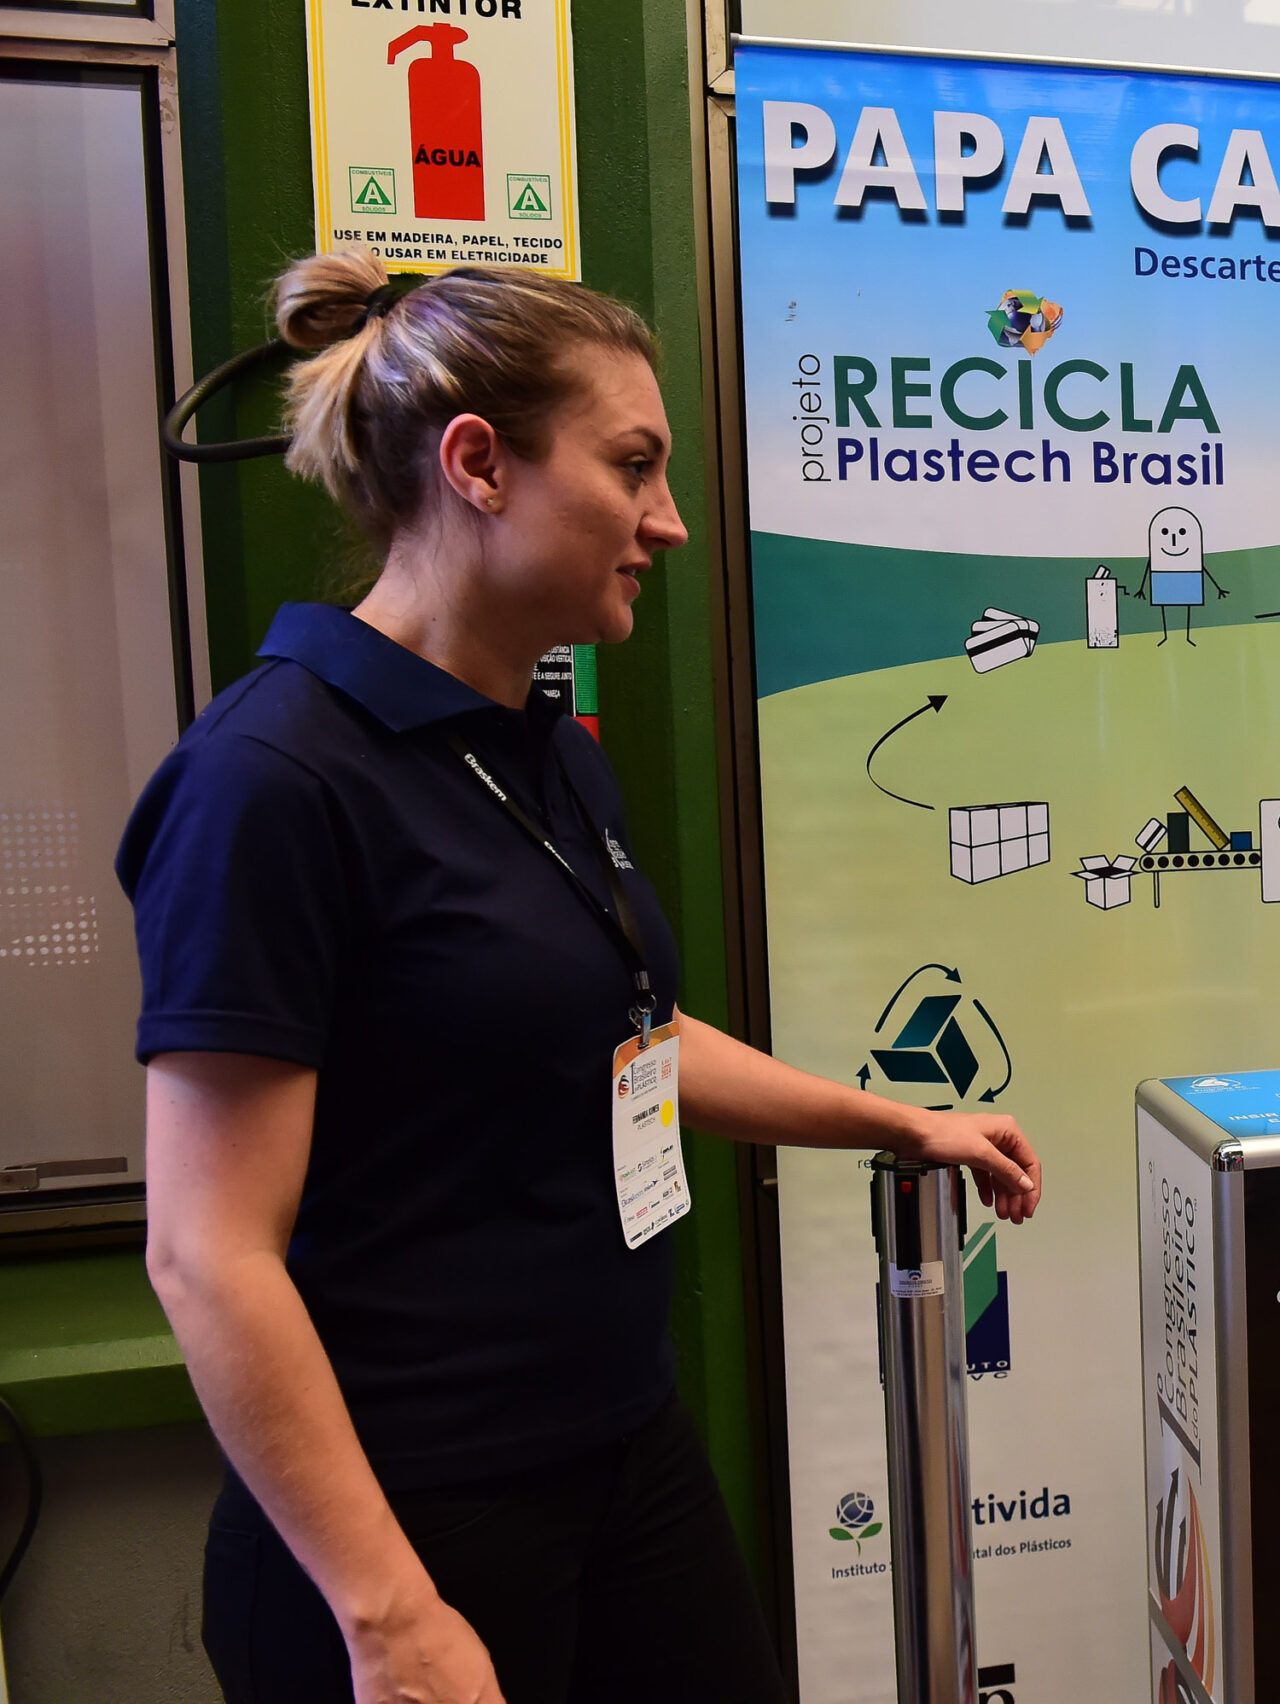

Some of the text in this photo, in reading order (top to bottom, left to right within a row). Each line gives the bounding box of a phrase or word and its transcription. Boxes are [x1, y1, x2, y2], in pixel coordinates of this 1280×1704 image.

[415, 144, 481, 167] ÁGUA
[762, 100, 1093, 217] PAPA
[333, 229, 563, 249] USE EM MADEIRA, PAPEL, TECIDO
[385, 247, 422, 259] USAR
[427, 249, 446, 260] EM
[451, 250, 549, 264] ELETRICIDADE
[792, 353, 831, 482] projeto
[833, 355, 1221, 434] RECICLA
[837, 437, 1224, 486] Plastech Brasil
[464, 753, 507, 801] Braskem
[1161, 1177, 1176, 1405] Congresso
[1172, 1186, 1188, 1423] Brasileiro
[971, 1371, 1008, 1381] VC
[971, 1487, 1071, 1525] tivida
[831, 1562, 887, 1579] Instituto
[995, 1545, 1016, 1557] dos
[1020, 1537, 1072, 1554] Plásticos
